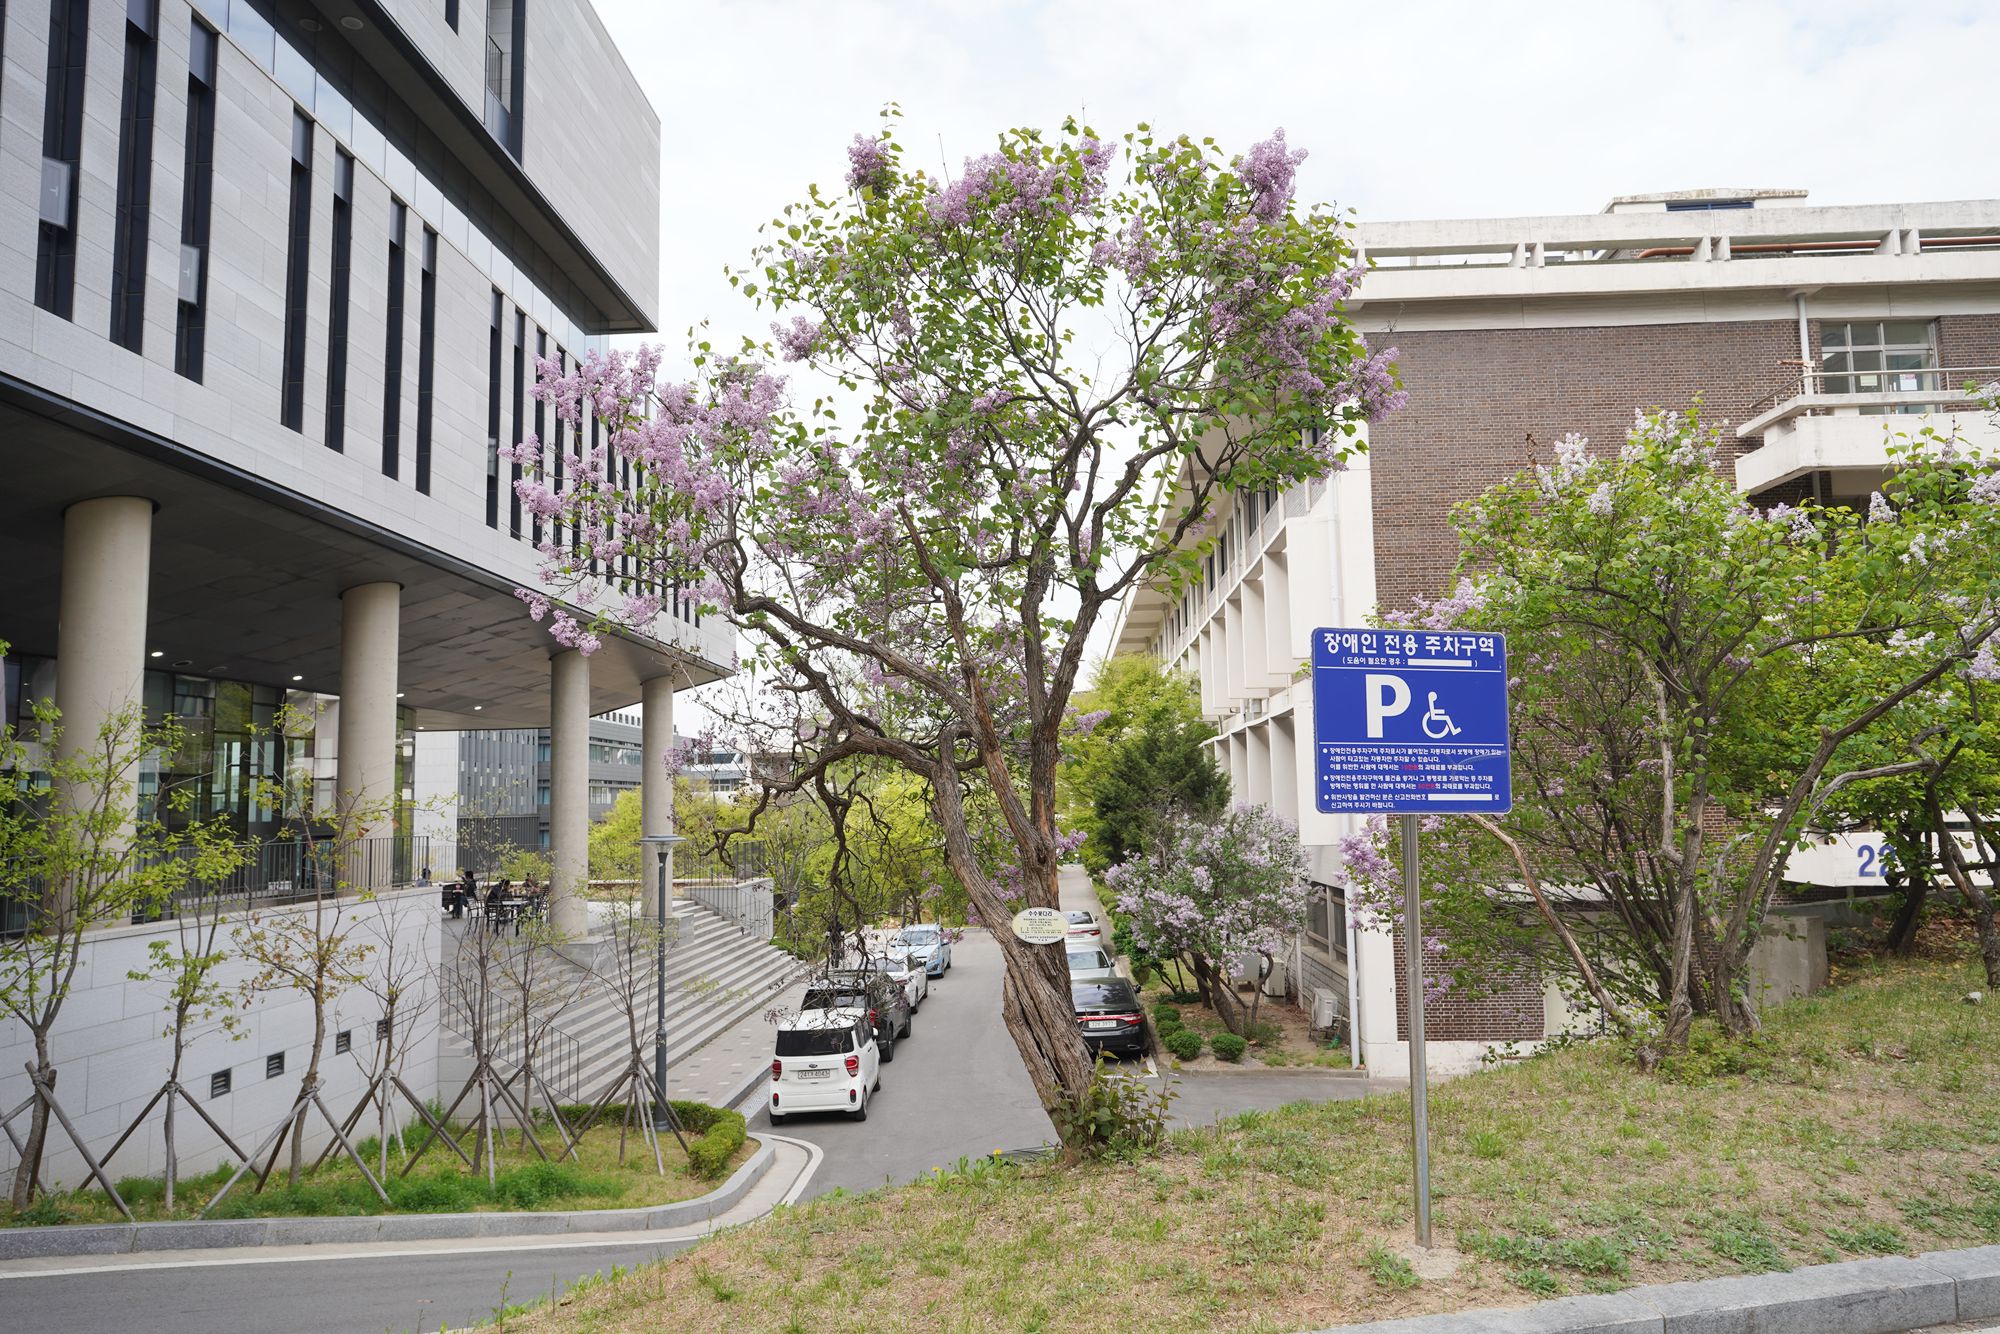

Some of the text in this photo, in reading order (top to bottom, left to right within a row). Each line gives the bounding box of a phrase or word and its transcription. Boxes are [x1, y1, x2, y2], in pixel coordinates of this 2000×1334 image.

[1324, 633, 1495, 657] 장애인 전용 주차구역
[1347, 656, 1366, 665] 도움이
[1368, 657, 1387, 666] 필요한
[1389, 657, 1401, 666] 경우
[1365, 674, 1412, 739] P
